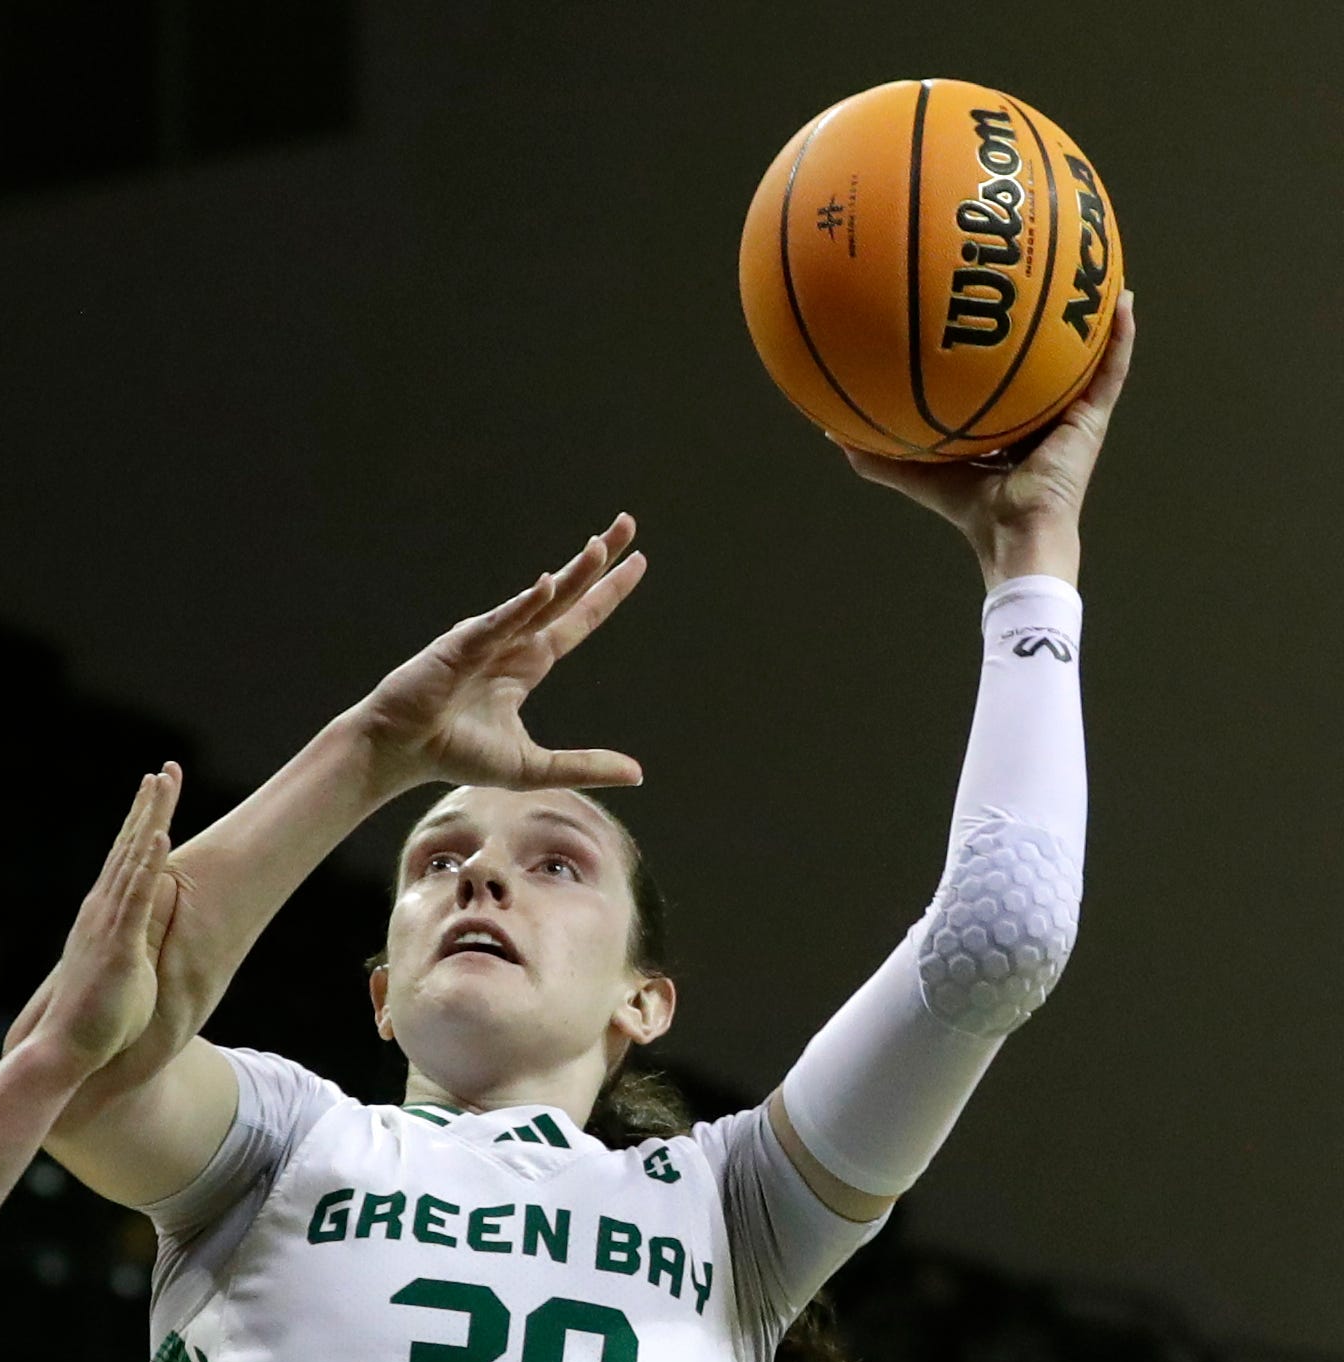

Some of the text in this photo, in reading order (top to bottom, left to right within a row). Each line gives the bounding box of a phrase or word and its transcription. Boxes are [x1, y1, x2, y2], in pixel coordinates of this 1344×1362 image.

[941, 108, 1024, 350] Wilson
[1061, 152, 1110, 344] NCAA
[307, 1188, 714, 1316] GREEN BAY
